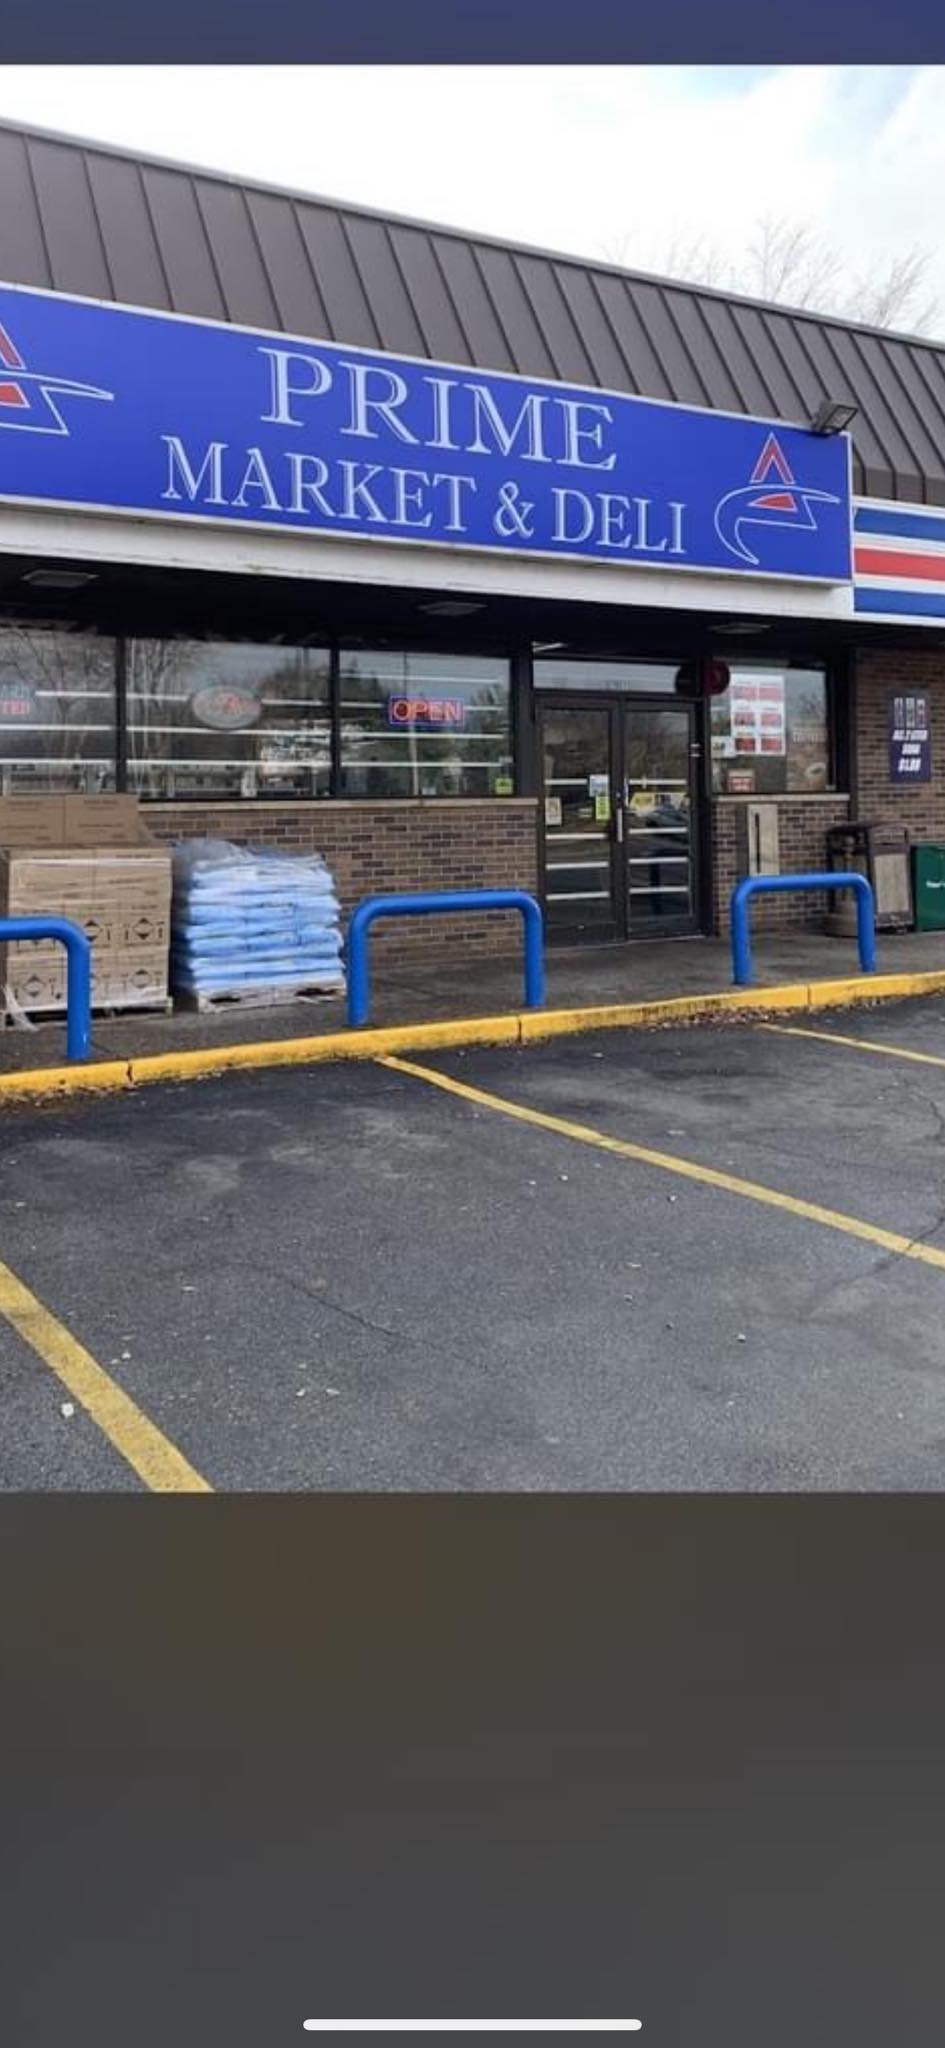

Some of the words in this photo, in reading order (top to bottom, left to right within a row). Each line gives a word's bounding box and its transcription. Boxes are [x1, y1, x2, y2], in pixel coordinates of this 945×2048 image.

[258, 347, 618, 472] PRIME
[160, 434, 477, 533] MARKET
[493, 481, 535, 540] &
[551, 487, 688, 555] DELI
[393, 699, 462, 722] OPEN
